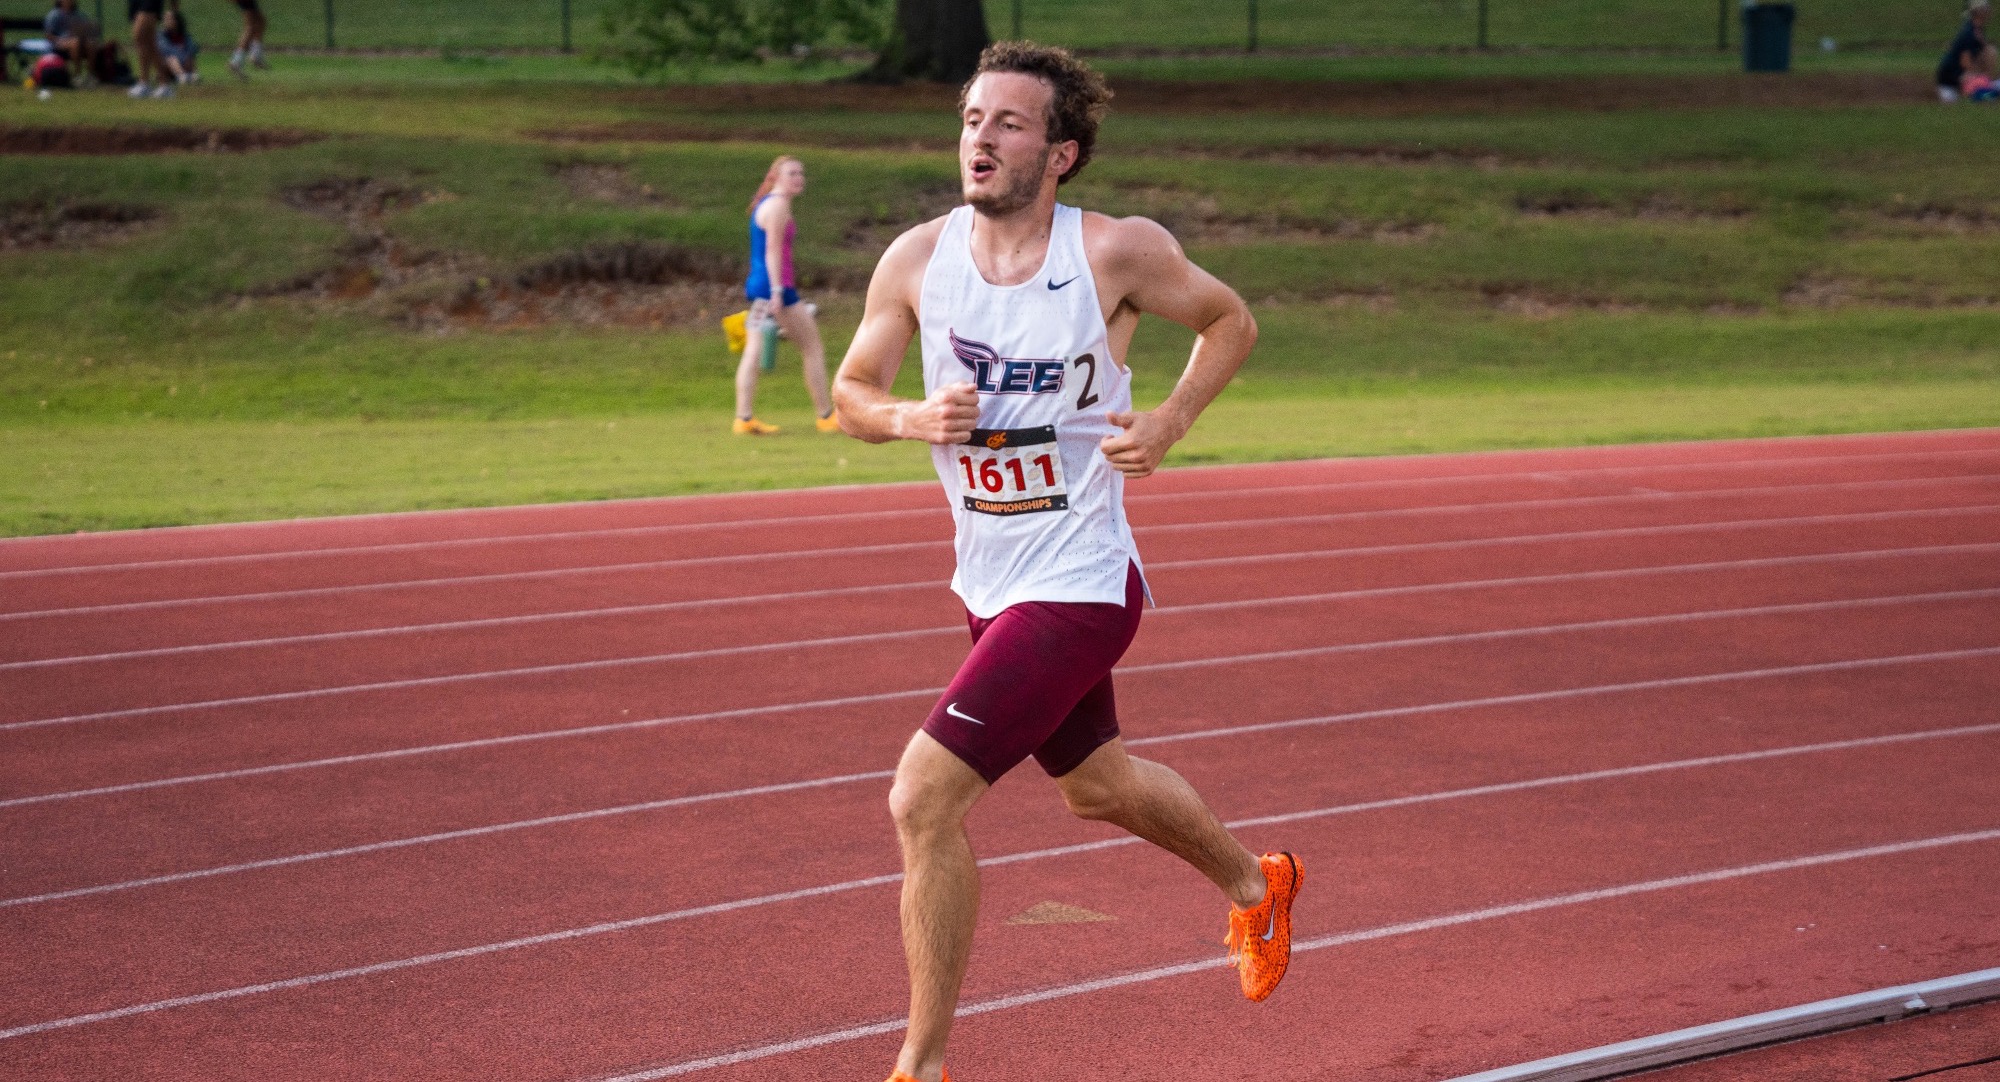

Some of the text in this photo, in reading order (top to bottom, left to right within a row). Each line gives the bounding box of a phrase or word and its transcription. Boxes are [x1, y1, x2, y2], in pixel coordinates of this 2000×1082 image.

[974, 358, 1064, 395] LEE
[1074, 353, 1099, 411] 2
[959, 454, 1056, 492] 1611
[975, 498, 1052, 513] CHAMPIONSHIPS
